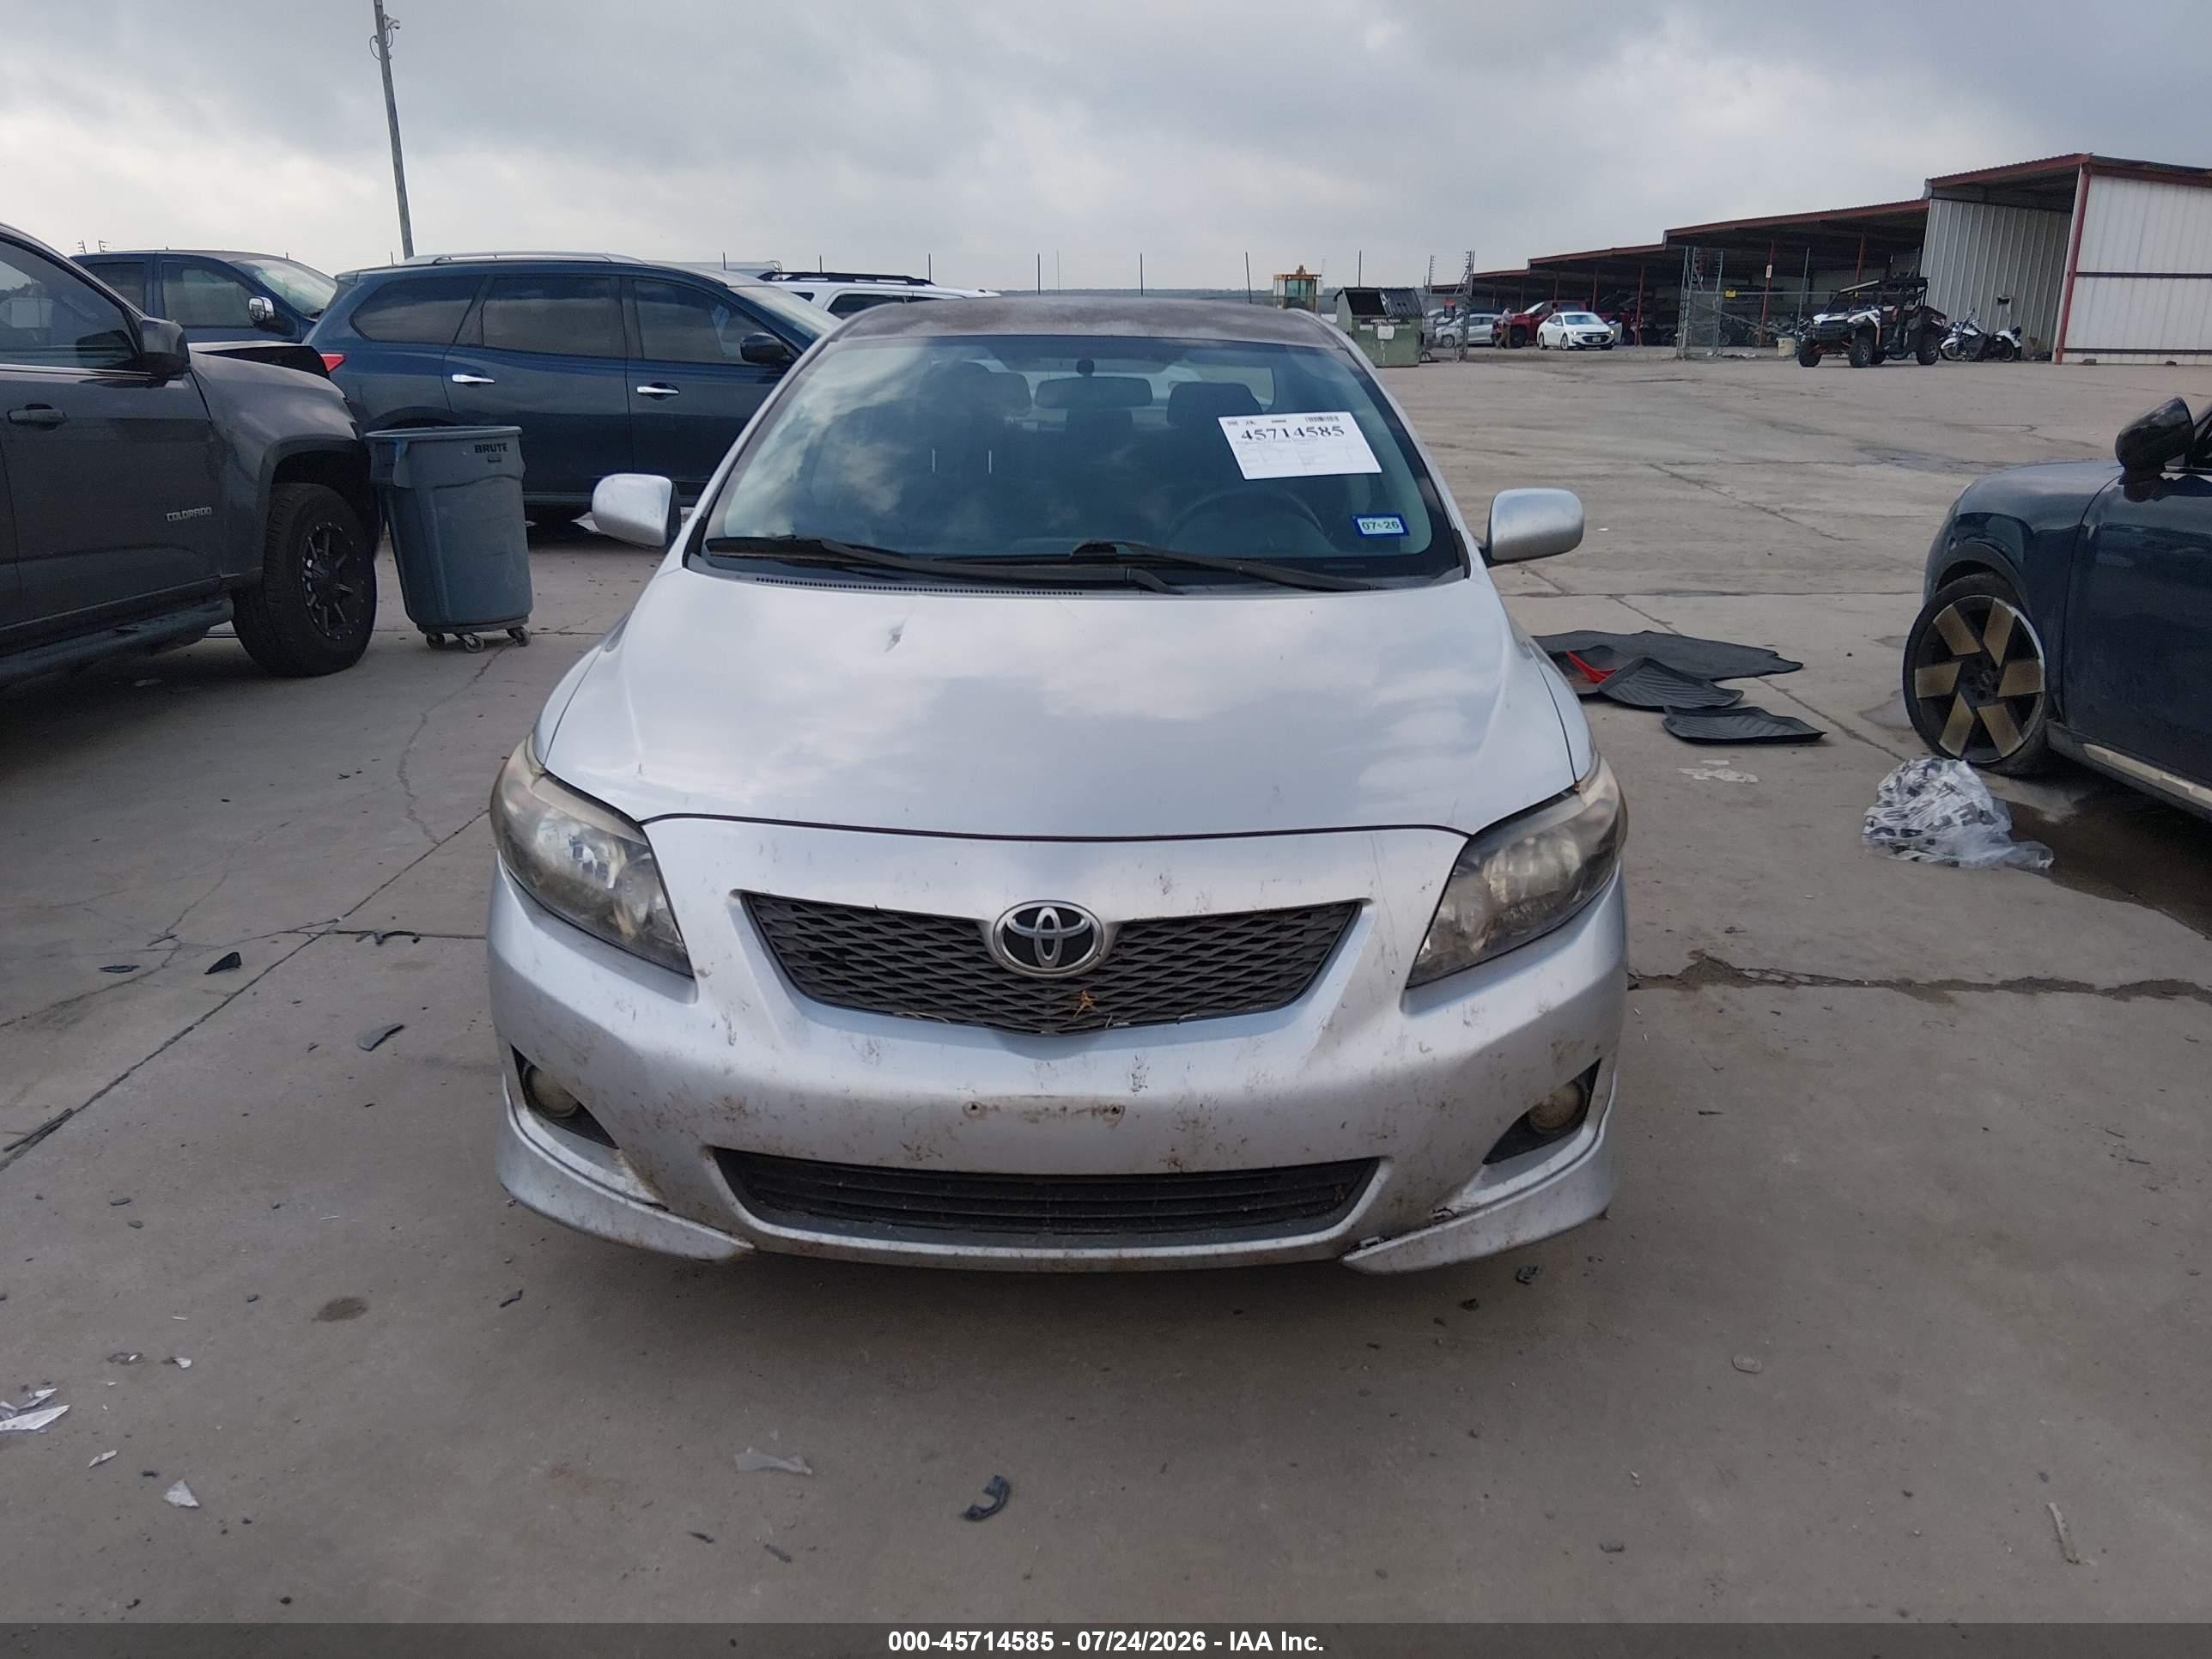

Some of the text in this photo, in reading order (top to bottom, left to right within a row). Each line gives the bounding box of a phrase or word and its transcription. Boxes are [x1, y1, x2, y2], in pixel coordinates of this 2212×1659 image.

[1241, 425, 1345, 441] 45714585
[474, 442, 508, 453] BRUTE
[166, 507, 212, 522] COLORADO
